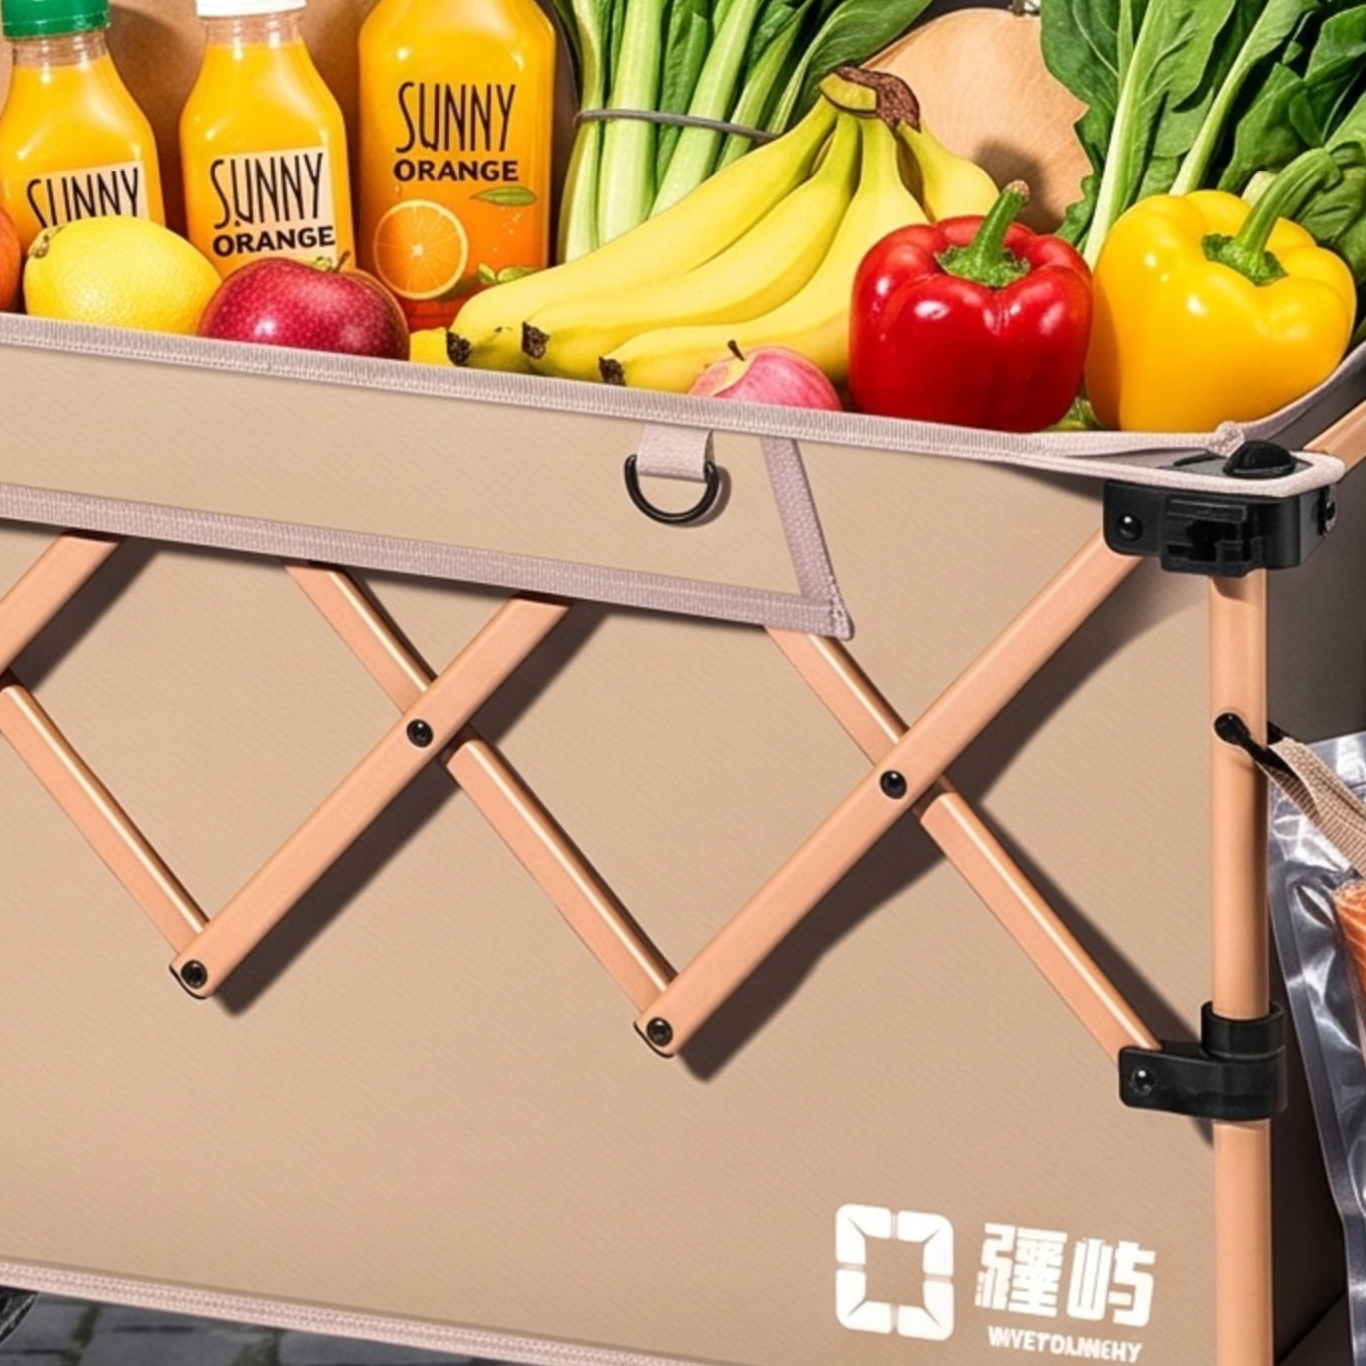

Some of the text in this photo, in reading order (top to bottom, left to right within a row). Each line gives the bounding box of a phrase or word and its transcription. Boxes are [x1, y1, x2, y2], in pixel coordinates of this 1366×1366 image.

[396, 81, 516, 153] SUNNY
[210, 152, 324, 230] SUNNY
[393, 159, 519, 182] ORANGE
[212, 225, 336, 258] ORANGE
